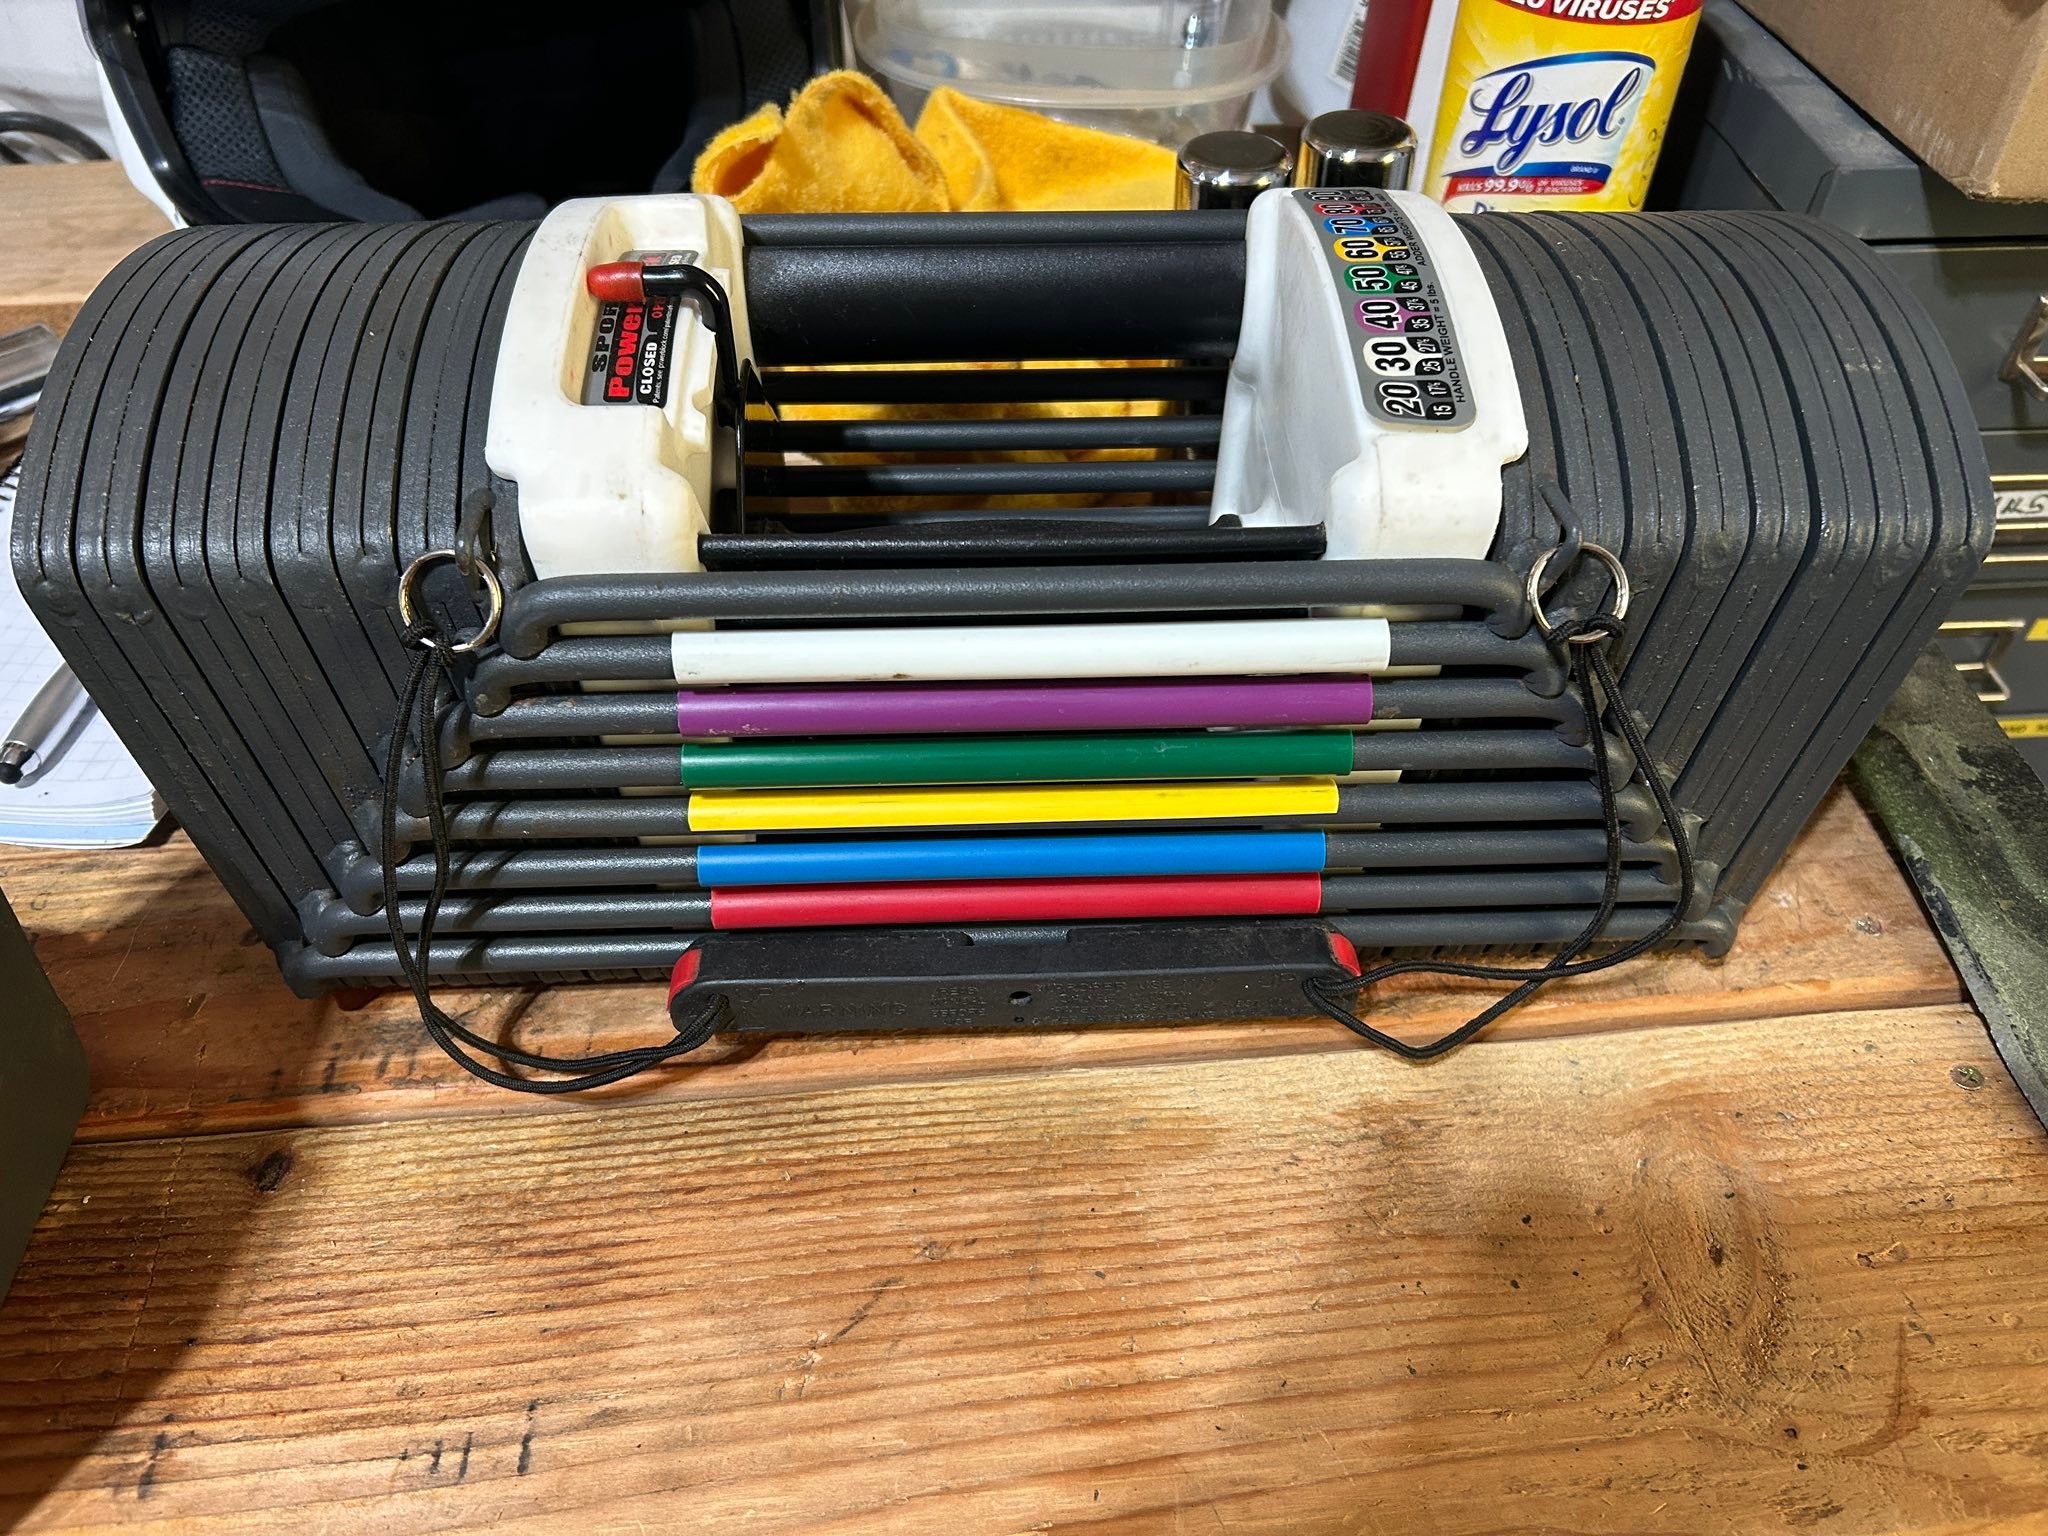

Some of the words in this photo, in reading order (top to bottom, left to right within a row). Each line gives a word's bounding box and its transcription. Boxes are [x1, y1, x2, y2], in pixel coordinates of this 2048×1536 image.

[1553, 0, 1669, 20] VIRUSES
[1461, 67, 1641, 174] Lysol
[1484, 177, 1536, 193] 99.9%
[1318, 203, 1358, 215] 80
[1329, 218, 1371, 235] 70
[1341, 239, 1379, 259] 60
[1408, 242, 1426, 266] ADDER
[1349, 266, 1391, 291] 50
[1400, 281, 1418, 290] 45
[1360, 300, 1402, 330] 40
[1411, 318, 1430, 329] 35
[592, 302, 620, 372] SPOR
[1434, 314, 1454, 356] WEIGHT
[1371, 342, 1411, 371] 30
[1422, 361, 1441, 372] 25
[640, 342, 658, 395] CLOSED
[1445, 357, 1466, 403] HANDLE
[1379, 381, 1425, 417] 20
[1433, 405, 1453, 416] 15
[779, 1001, 908, 1017] WARNING
